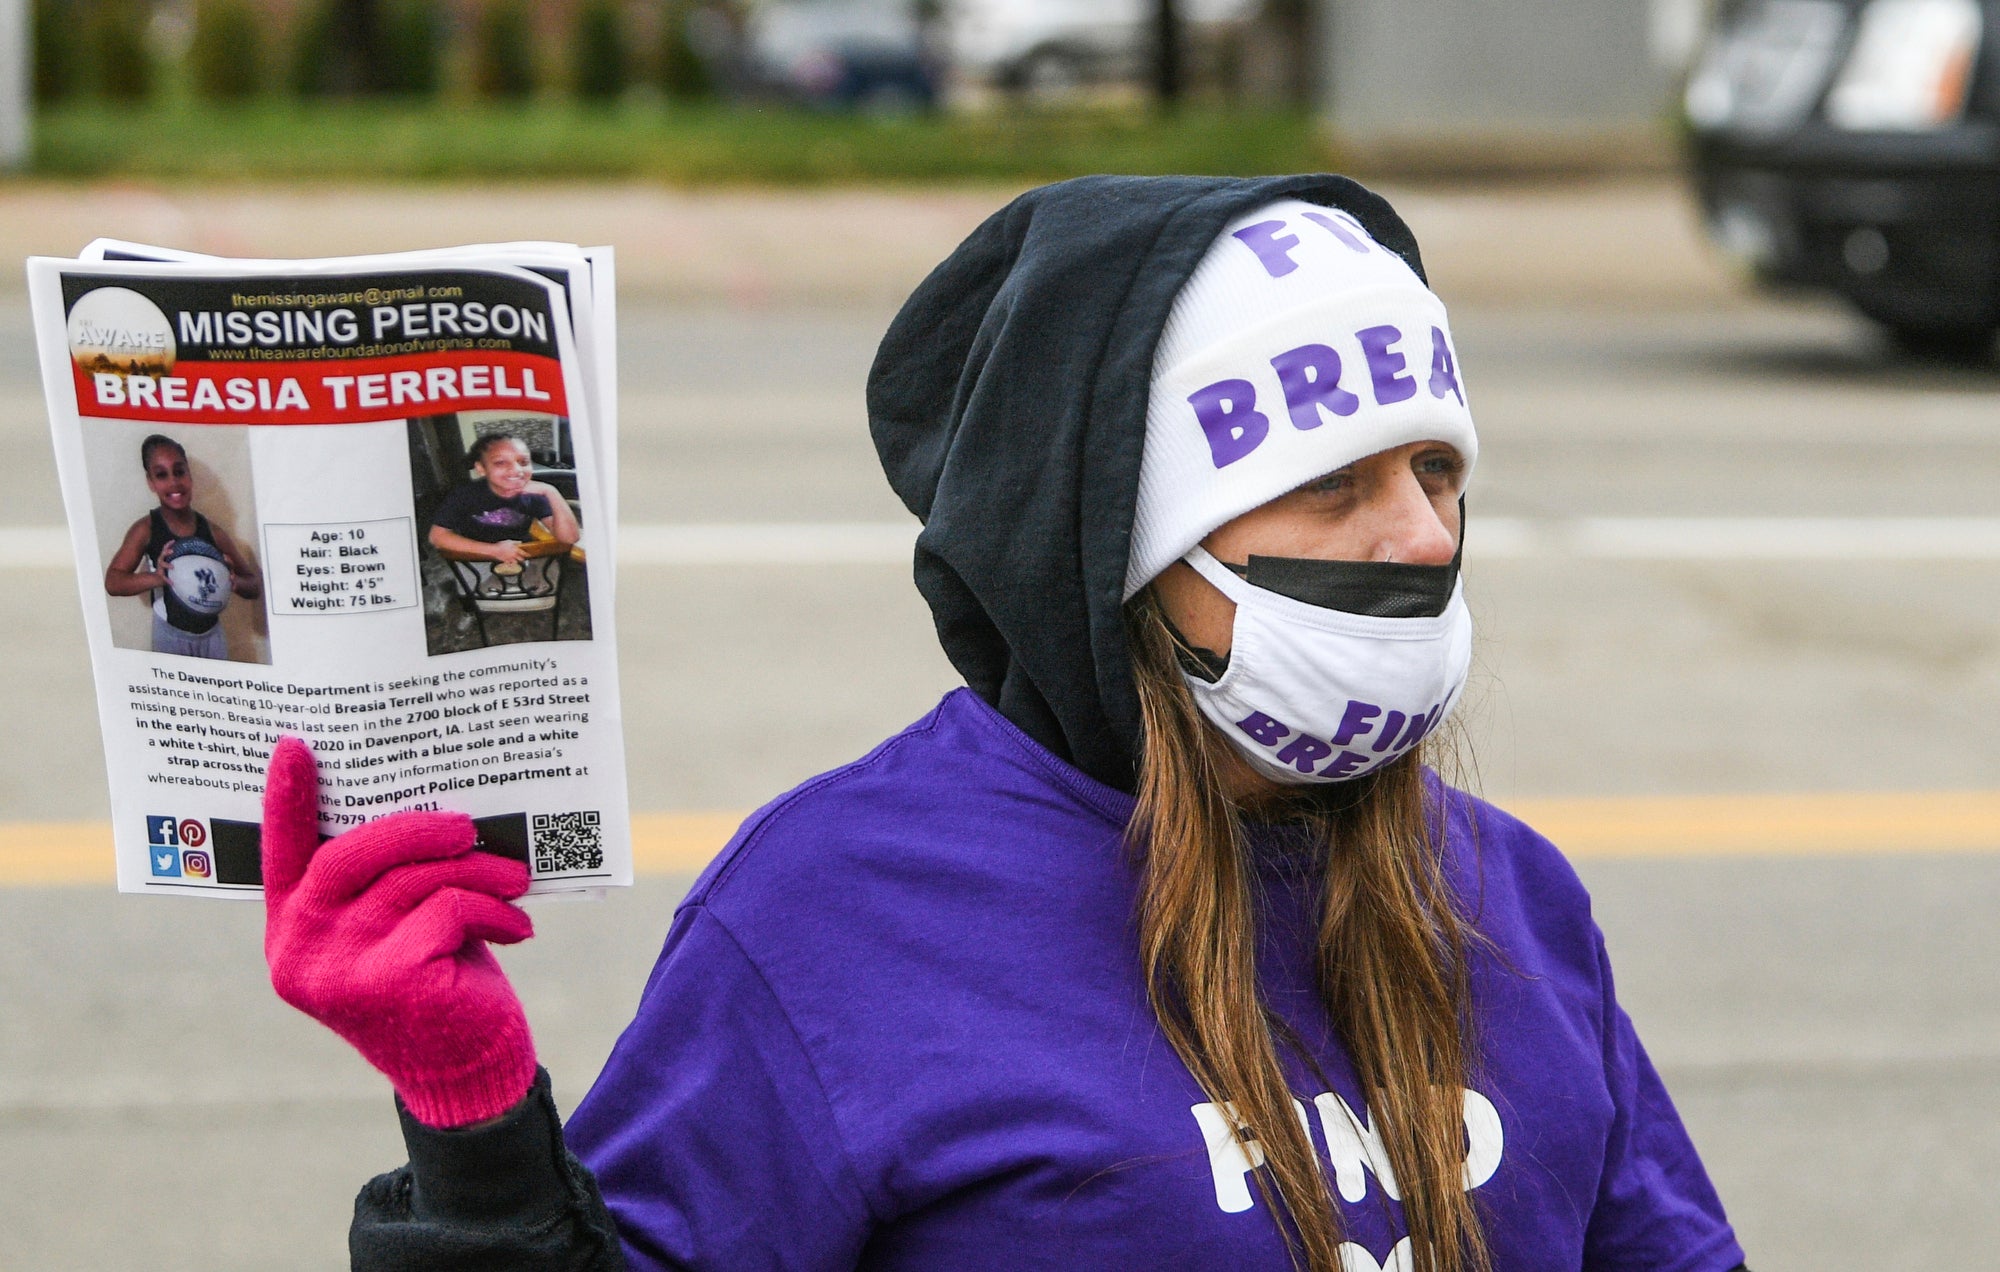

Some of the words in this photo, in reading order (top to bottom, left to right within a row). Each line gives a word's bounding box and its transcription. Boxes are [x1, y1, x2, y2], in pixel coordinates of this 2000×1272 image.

[78, 327, 165, 348] AWARE
[178, 308, 359, 344] MISSING
[372, 302, 549, 341] PERSON
[94, 372, 310, 411] BREASIA
[322, 365, 550, 409] TERRELL
[300, 547, 332, 558] Hair:
[339, 544, 379, 557] Black
[311, 531, 343, 544] Age:
[348, 529, 365, 540] 10
[296, 564, 335, 577] Eyes:
[340, 562, 386, 574] Brown
[300, 580, 349, 594] Height:
[291, 597, 345, 610] Weight:
[350, 595, 367, 606] 75
[371, 594, 396, 605] lbs.
[128, 684, 190, 699] assistance
[193, 690, 205, 701] in
[207, 692, 257, 710] locating
[259, 699, 331, 714] 10-year-old
[335, 701, 386, 714] Breasia
[389, 692, 433, 708] Terrell
[436, 689, 466, 702] who
[469, 684, 495, 697] was
[500, 675, 559, 692] reported
[562, 677, 577, 686] as
[580, 676, 588, 685] a
[151, 667, 175, 680] The
[178, 671, 243, 689] Davenport
[246, 679, 284, 694] Police
[287, 684, 371, 698] Department
[374, 681, 384, 692] is
[388, 675, 439, 690] seeking
[443, 670, 465, 682] the
[469, 658, 557, 678] community's
[130, 701, 177, 716] missing
[179, 706, 225, 721] person.
[228, 711, 272, 726] Breasia
[275, 719, 298, 731] was
[301, 720, 325, 733] last
[328, 723, 359, 733] seen
[364, 719, 377, 730] in
[380, 716, 402, 728] the
[406, 709, 439, 724] 2700
[444, 703, 481, 718] block
[483, 699, 498, 711] of
[502, 700, 509, 709] E
[513, 693, 545, 706] 53rd
[548, 693, 590, 705] Street
[136, 717, 148, 729] in
[151, 719, 172, 731] the
[176, 723, 207, 736] early
[210, 726, 246, 740] hours
[249, 731, 261, 742] of
[264, 733, 281, 744] Jul
[312, 740, 344, 751] 2020
[348, 739, 361, 751] in
[366, 728, 442, 748] Davenport,
[446, 723, 464, 736] IA.
[469, 719, 494, 732] Last
[499, 716, 530, 727] seen
[534, 711, 589, 724] wearing
[1331, 686, 1456, 752] FIN
[148, 738, 155, 747] a
[159, 737, 195, 750] white
[198, 742, 240, 757] t-shirt,
[242, 746, 270, 760] blue
[317, 758, 341, 770] and
[345, 756, 384, 770] slides
[387, 749, 418, 763] with
[421, 747, 429, 757] a
[433, 741, 463, 755] blue
[467, 738, 495, 750] sole
[499, 732, 524, 746] and
[528, 732, 536, 742] a
[539, 728, 579, 741] white
[168, 755, 199, 768] strap
[203, 759, 242, 772] across
[244, 763, 265, 775] the
[317, 776, 333, 787] ou
[337, 776, 369, 787] have
[373, 771, 396, 784] any
[399, 758, 479, 778] information
[482, 754, 499, 765] on
[503, 747, 563, 763] Breasia's
[148, 772, 230, 789] whereabouts
[233, 780, 265, 793] pleas
[321, 794, 341, 806] the
[345, 784, 425, 807] Davenport
[429, 776, 475, 794] Police
[478, 766, 571, 786] Department
[575, 766, 589, 776] at
